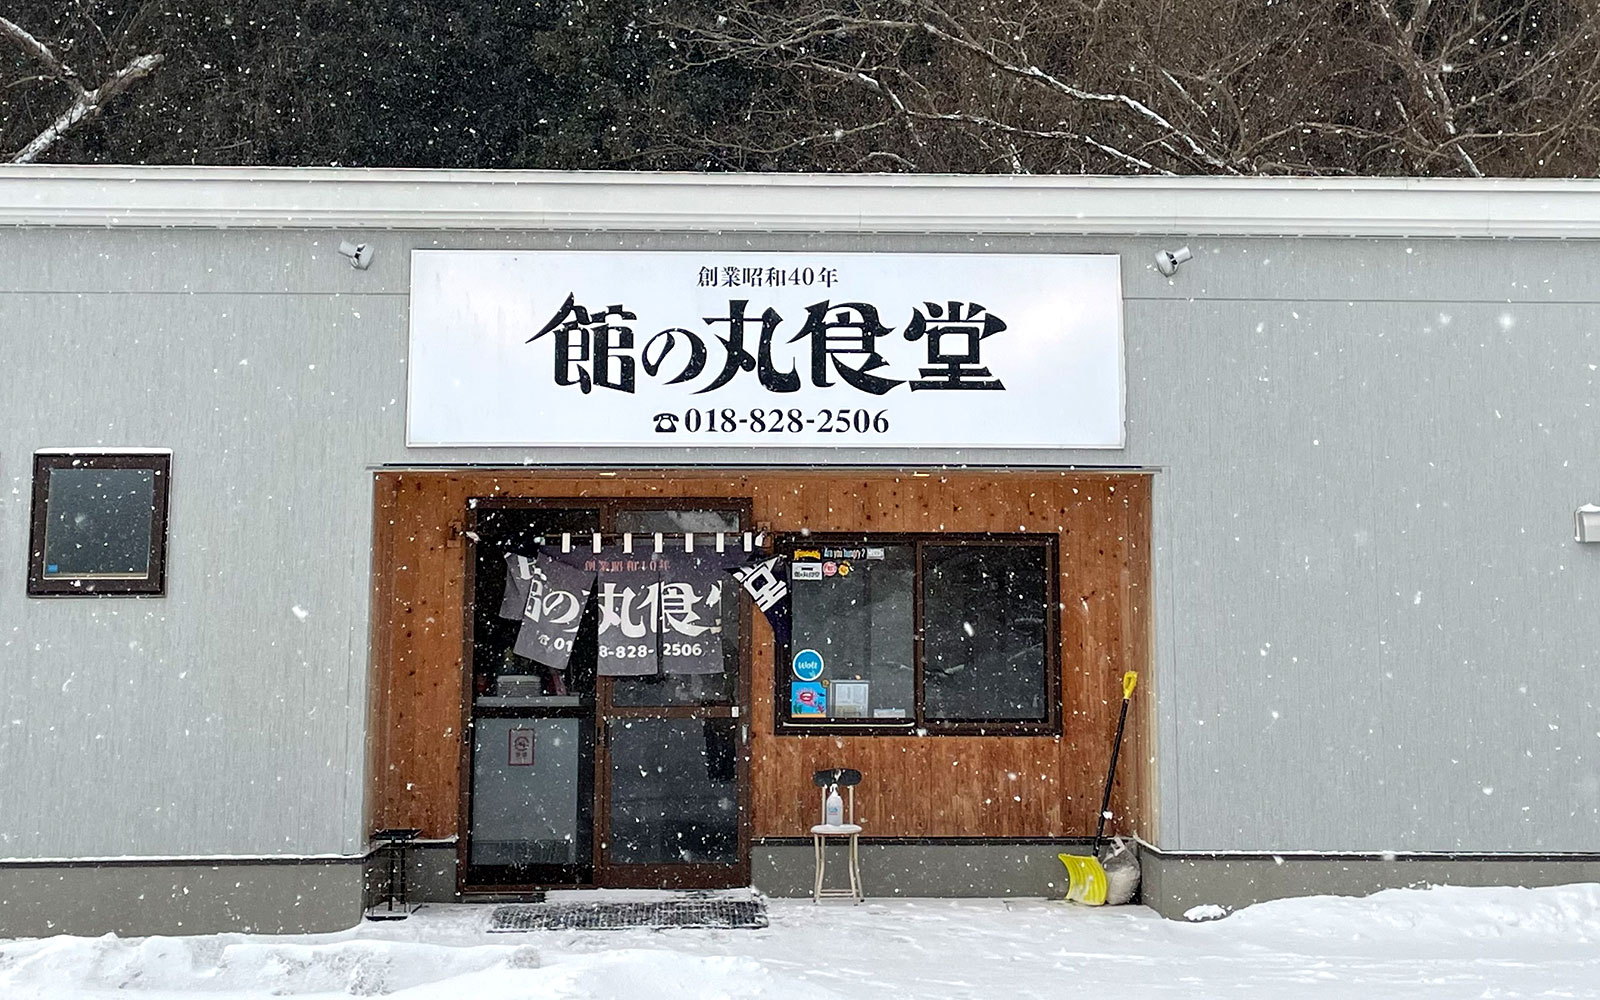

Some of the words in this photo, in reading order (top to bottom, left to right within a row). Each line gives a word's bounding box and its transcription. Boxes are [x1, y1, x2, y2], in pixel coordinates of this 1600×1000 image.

[696, 266, 839, 288] 創業昭和40年
[524, 291, 1008, 396] 館の丸食堂
[684, 408, 890, 433] 018-828-2506
